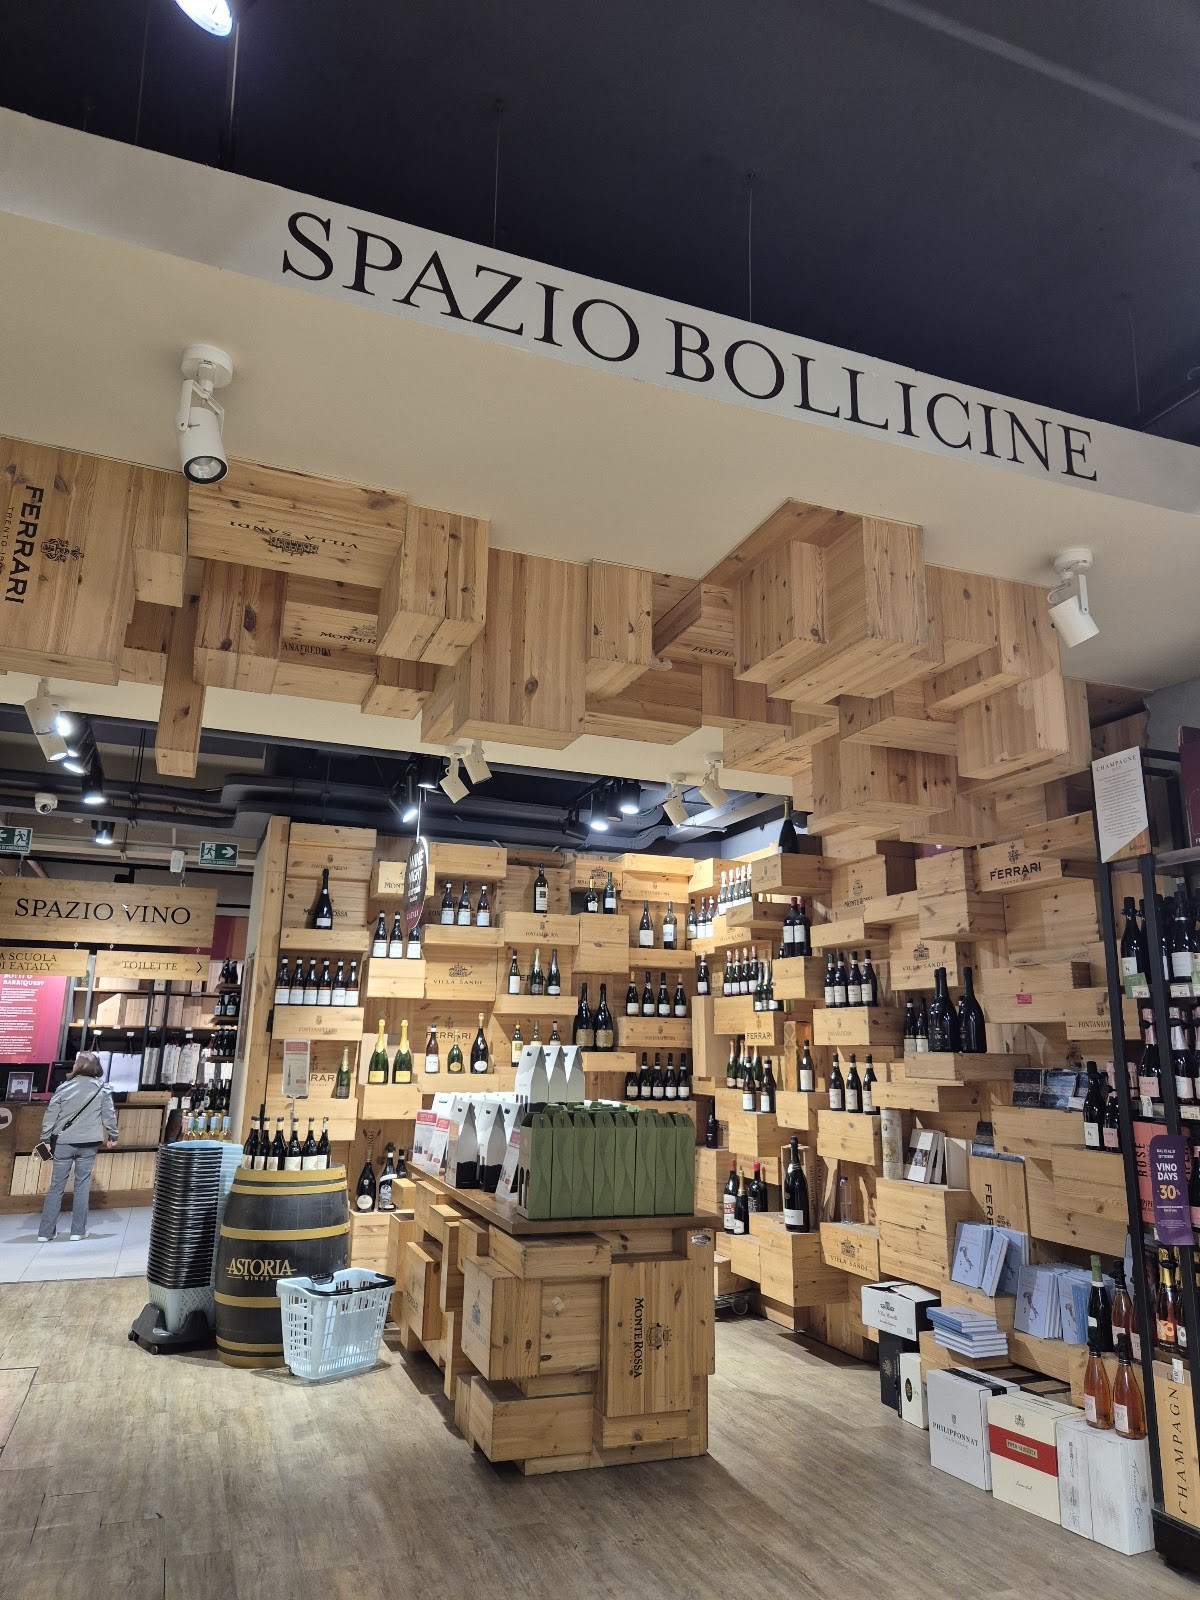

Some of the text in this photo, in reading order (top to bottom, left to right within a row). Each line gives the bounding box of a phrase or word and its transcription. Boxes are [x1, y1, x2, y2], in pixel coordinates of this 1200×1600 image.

[282, 211, 1098, 482] SPAZIO BOLLICINE
[1, 507, 14, 547] TRENTO
[230, 521, 359, 549] VILLA SANDI
[5, 485, 45, 605] FERRARI
[1096, 754, 1137, 772] CHAMPAGNE
[990, 862, 1042, 881] FERRARI
[15, 898, 191, 925] SPAZIO VINO
[9, 953, 57, 962] SCUOLA
[10, 962, 53, 971] EATALY
[121, 960, 178, 971] TOILETTE
[747, 1032, 772, 1040] FERRARI
[1156, 1162, 1177, 1172] VINO
[1157, 1172, 1178, 1181] DAYS
[227, 1258, 294, 1276] ASTORIA
[932, 1421, 979, 1447] PHILIPPONNAT
